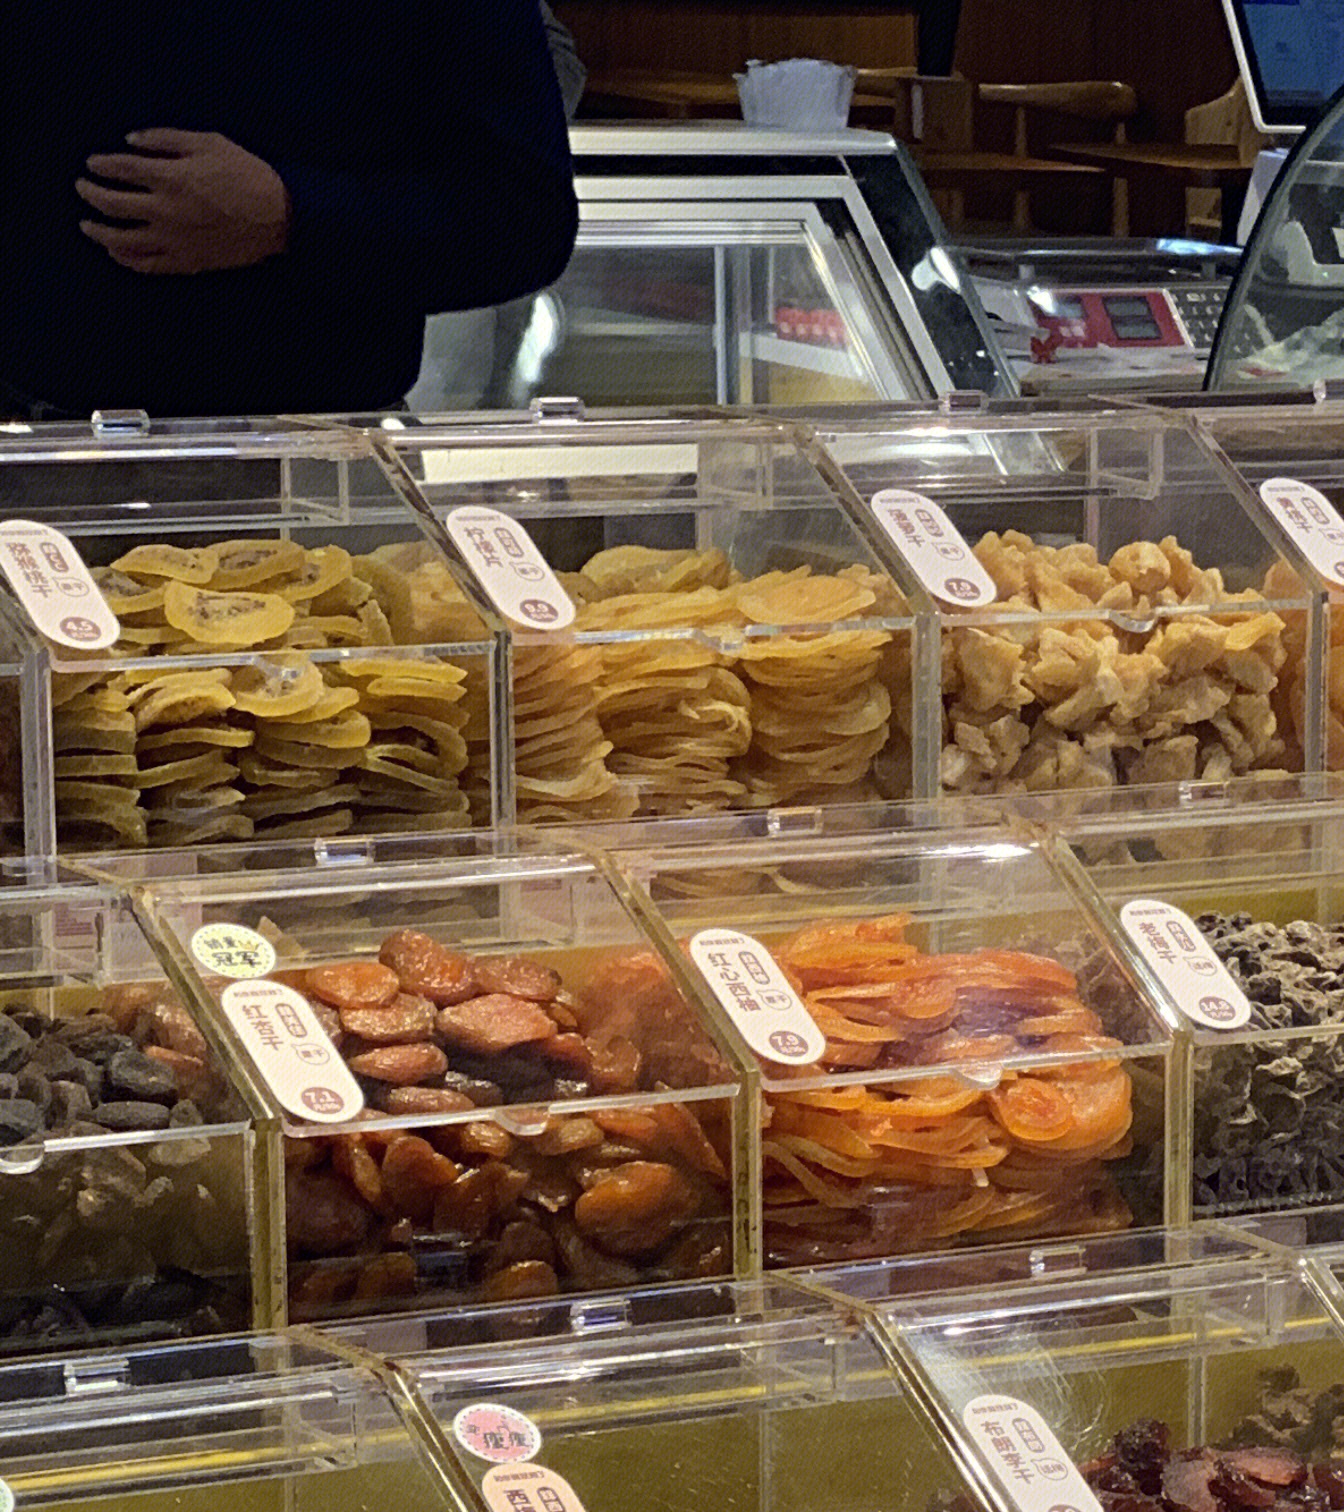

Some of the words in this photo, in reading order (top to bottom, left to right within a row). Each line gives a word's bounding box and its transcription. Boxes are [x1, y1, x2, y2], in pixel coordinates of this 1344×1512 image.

[1139, 922, 1177, 965] 老梅干
[708, 953, 761, 1013] 红心西柚
[242, 1005, 284, 1051] 红杏干
[981, 1421, 1034, 1485] 布朗李干
